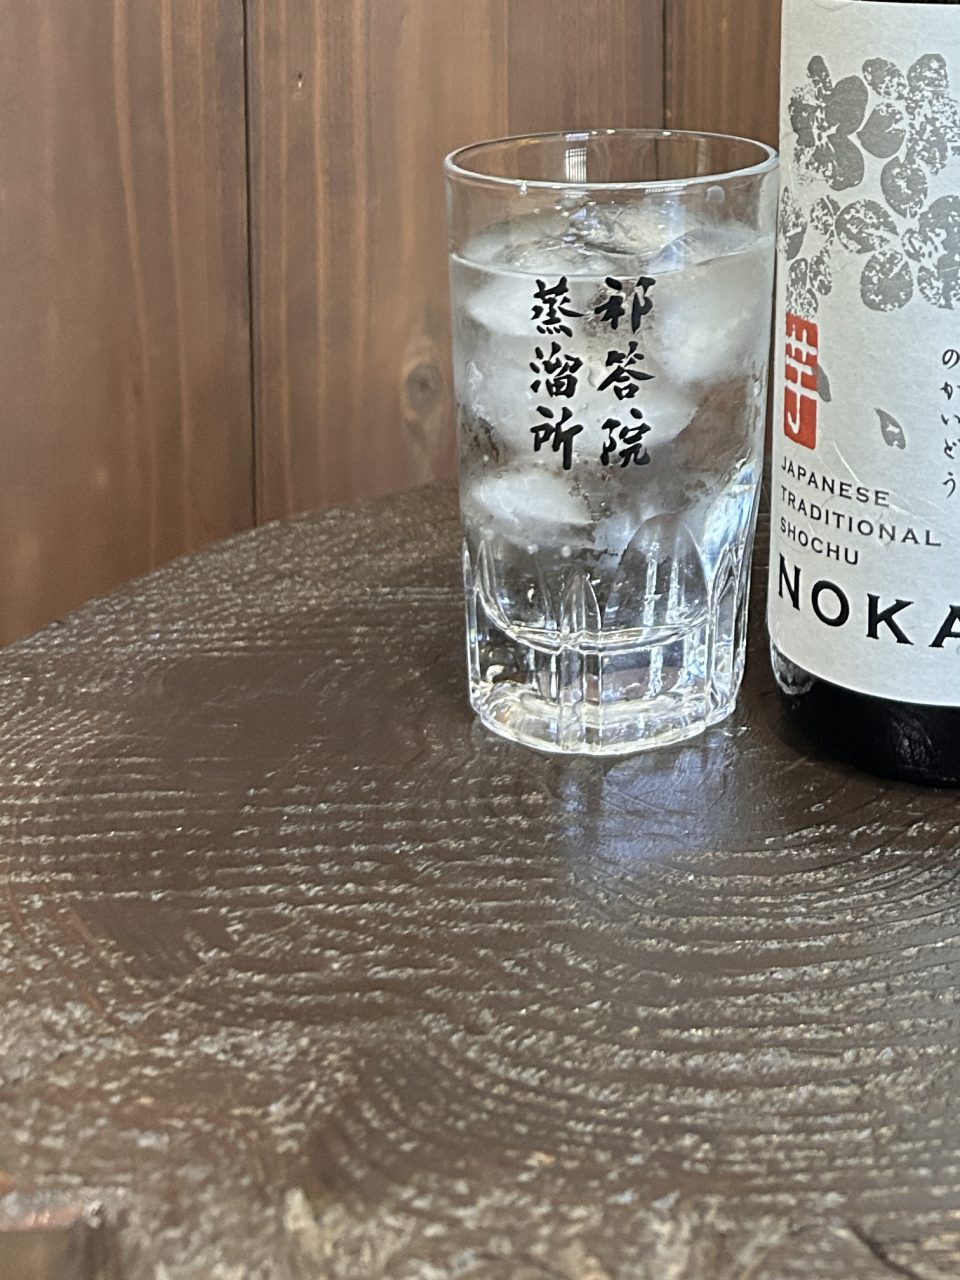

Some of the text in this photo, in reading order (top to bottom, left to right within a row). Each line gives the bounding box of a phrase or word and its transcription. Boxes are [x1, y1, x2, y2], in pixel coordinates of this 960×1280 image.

[530, 276, 585, 470] 蒸溜所
[595, 276, 656, 468] 祁答院
[781, 456, 890, 508] JAPANESE
[780, 517, 860, 566] SHOCHU
[781, 485, 942, 547] TRADITIONAL
